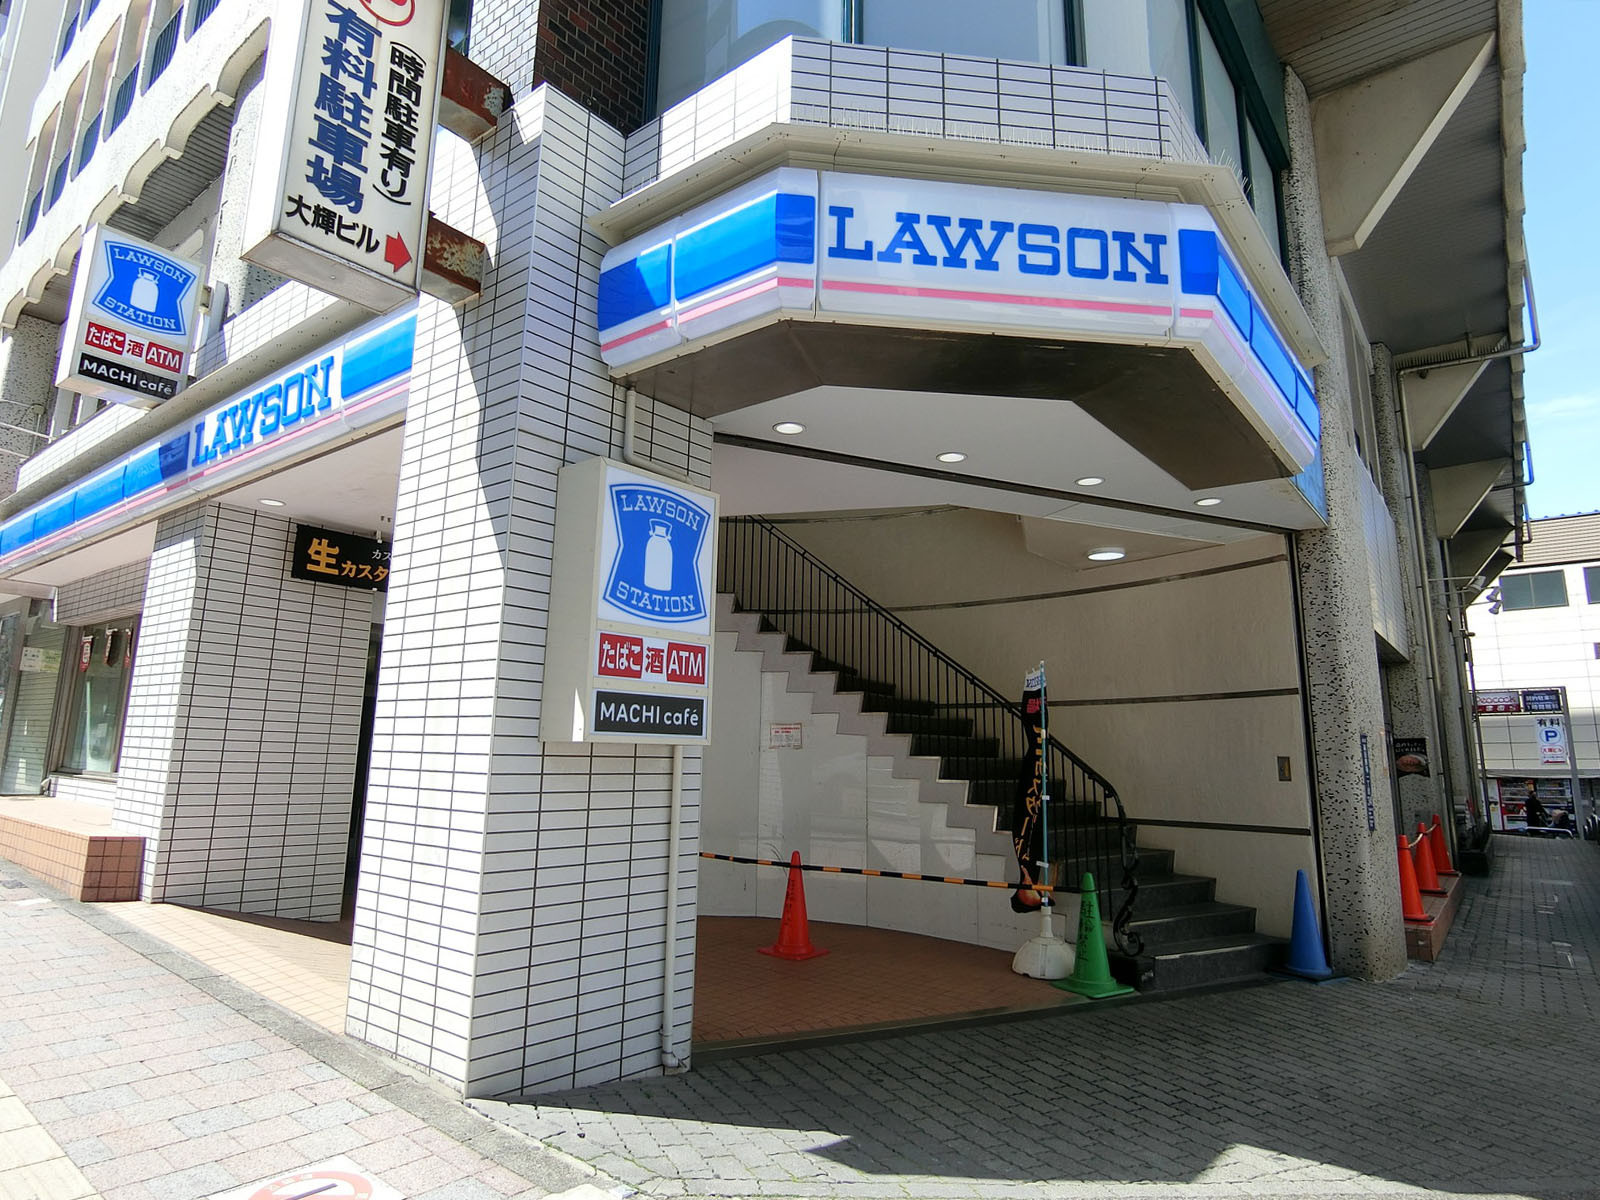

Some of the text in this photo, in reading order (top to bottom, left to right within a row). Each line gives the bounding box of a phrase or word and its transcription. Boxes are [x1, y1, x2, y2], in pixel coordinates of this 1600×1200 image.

[304, 0, 383, 215] 有料駐車場
[285, 194, 380, 254] 大輝ビル
[828, 204, 1169, 285] LAWSON
[113, 247, 188, 284] LAWSON
[103, 296, 177, 330] STATION
[87, 326, 180, 369] たばこ 酒 ATM
[82, 359, 173, 396] MACHI café
[191, 355, 335, 467] LAWSON
[620, 493, 701, 532] LAWSON
[306, 537, 389, 582] 生カスタ
[615, 580, 696, 614] STATION
[601, 639, 704, 678] たばこ 酒 ATM
[599, 700, 700, 727] MACHI café
[1544, 730, 1559, 742] P
